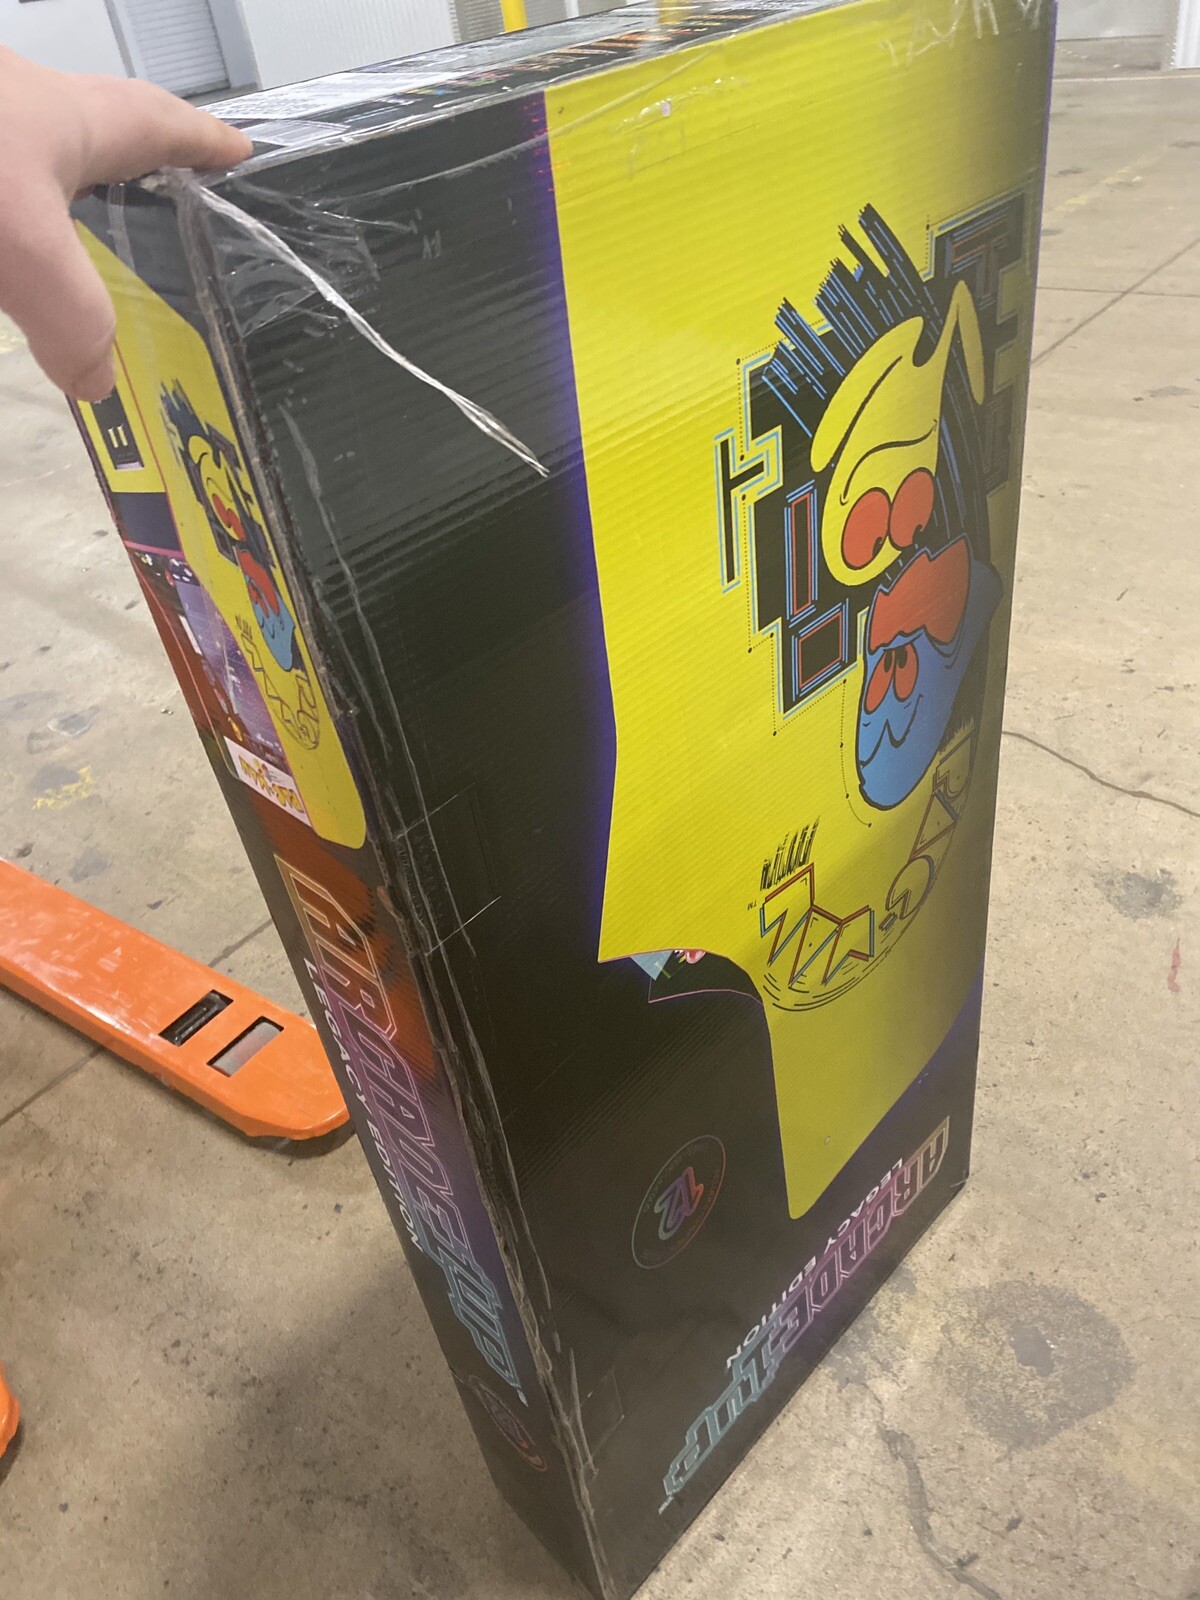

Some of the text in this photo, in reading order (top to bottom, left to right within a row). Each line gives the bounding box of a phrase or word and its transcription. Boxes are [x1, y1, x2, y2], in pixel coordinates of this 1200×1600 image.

[304, 957, 423, 1252] LEGACY EDITION
[726, 1157, 903, 1370] LEGACY EDITION
